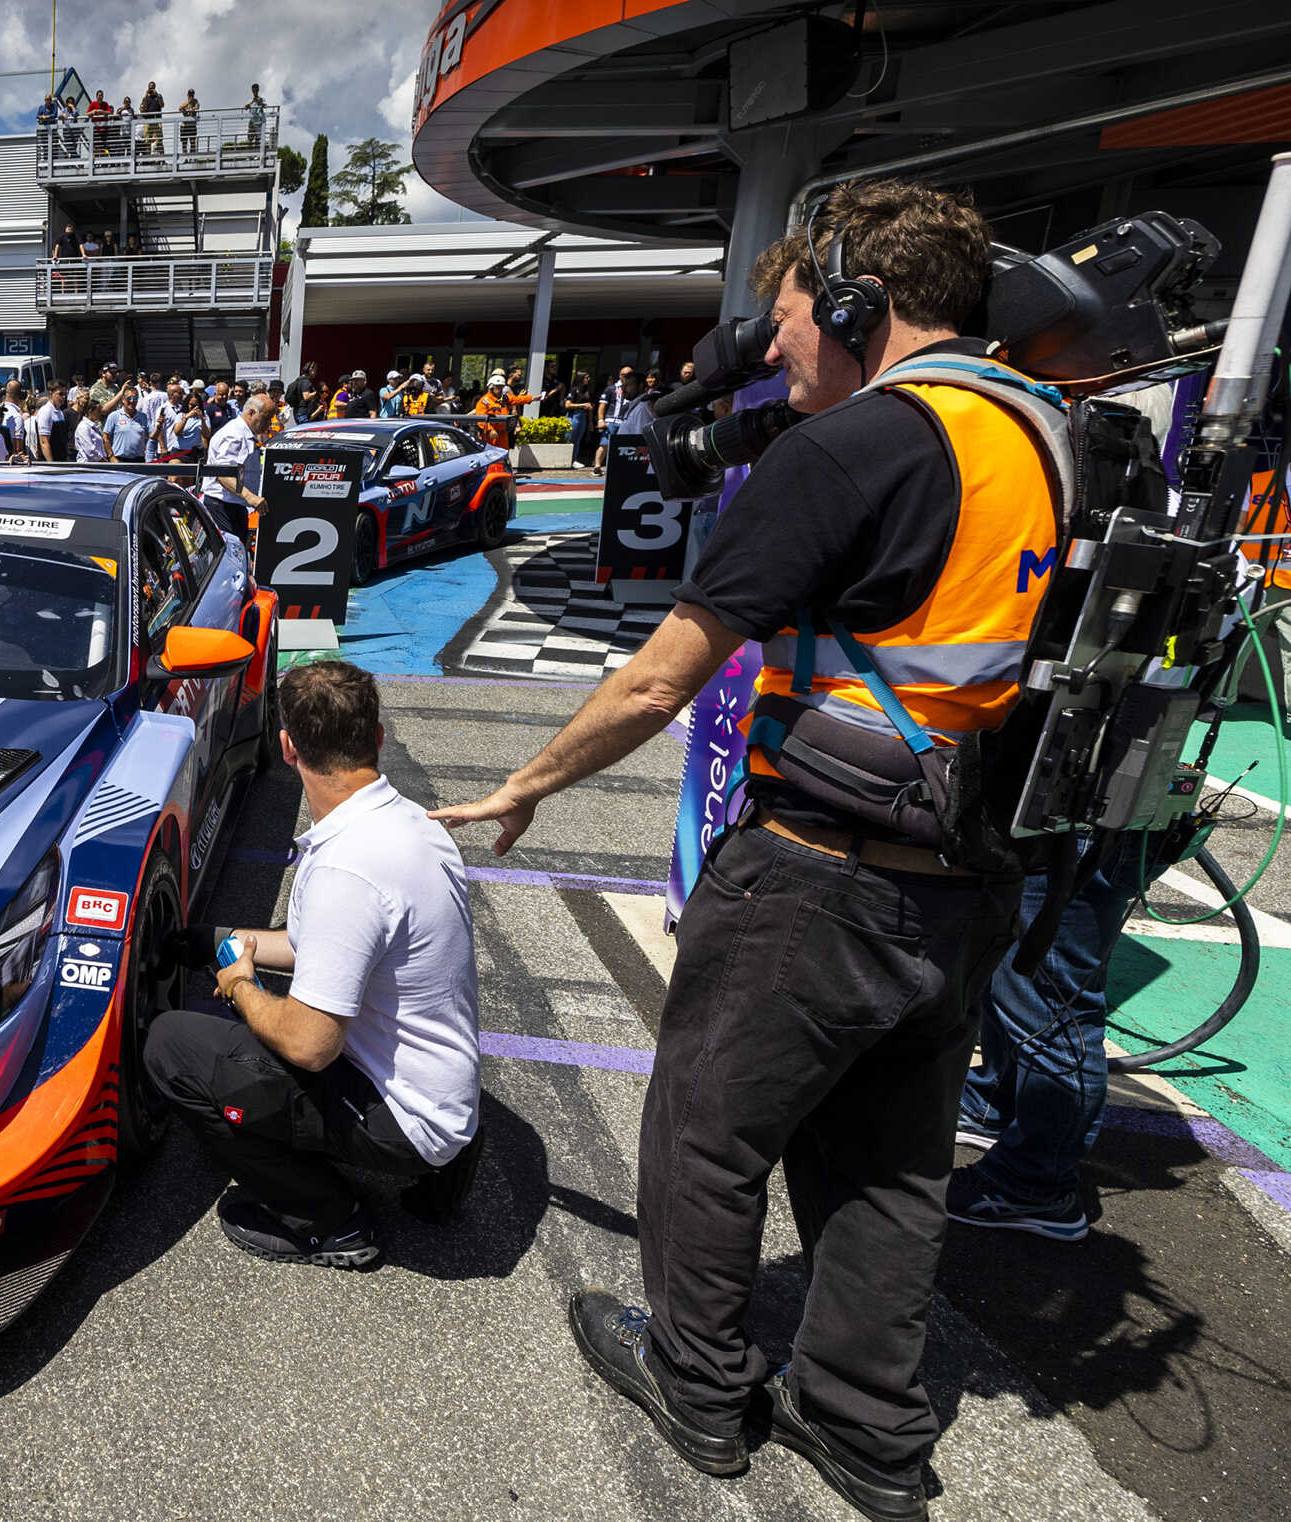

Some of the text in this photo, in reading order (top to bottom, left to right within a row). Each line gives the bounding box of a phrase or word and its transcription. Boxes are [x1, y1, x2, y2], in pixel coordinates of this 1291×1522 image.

[9, 339, 28, 352] 25
[273, 462, 305, 475] TCR
[28, 519, 60, 529] TIRE
[617, 491, 682, 550] 3
[271, 517, 339, 585] 2
[701, 741, 730, 855] enel
[82, 901, 113, 912] BRC
[61, 963, 111, 986] OMP
